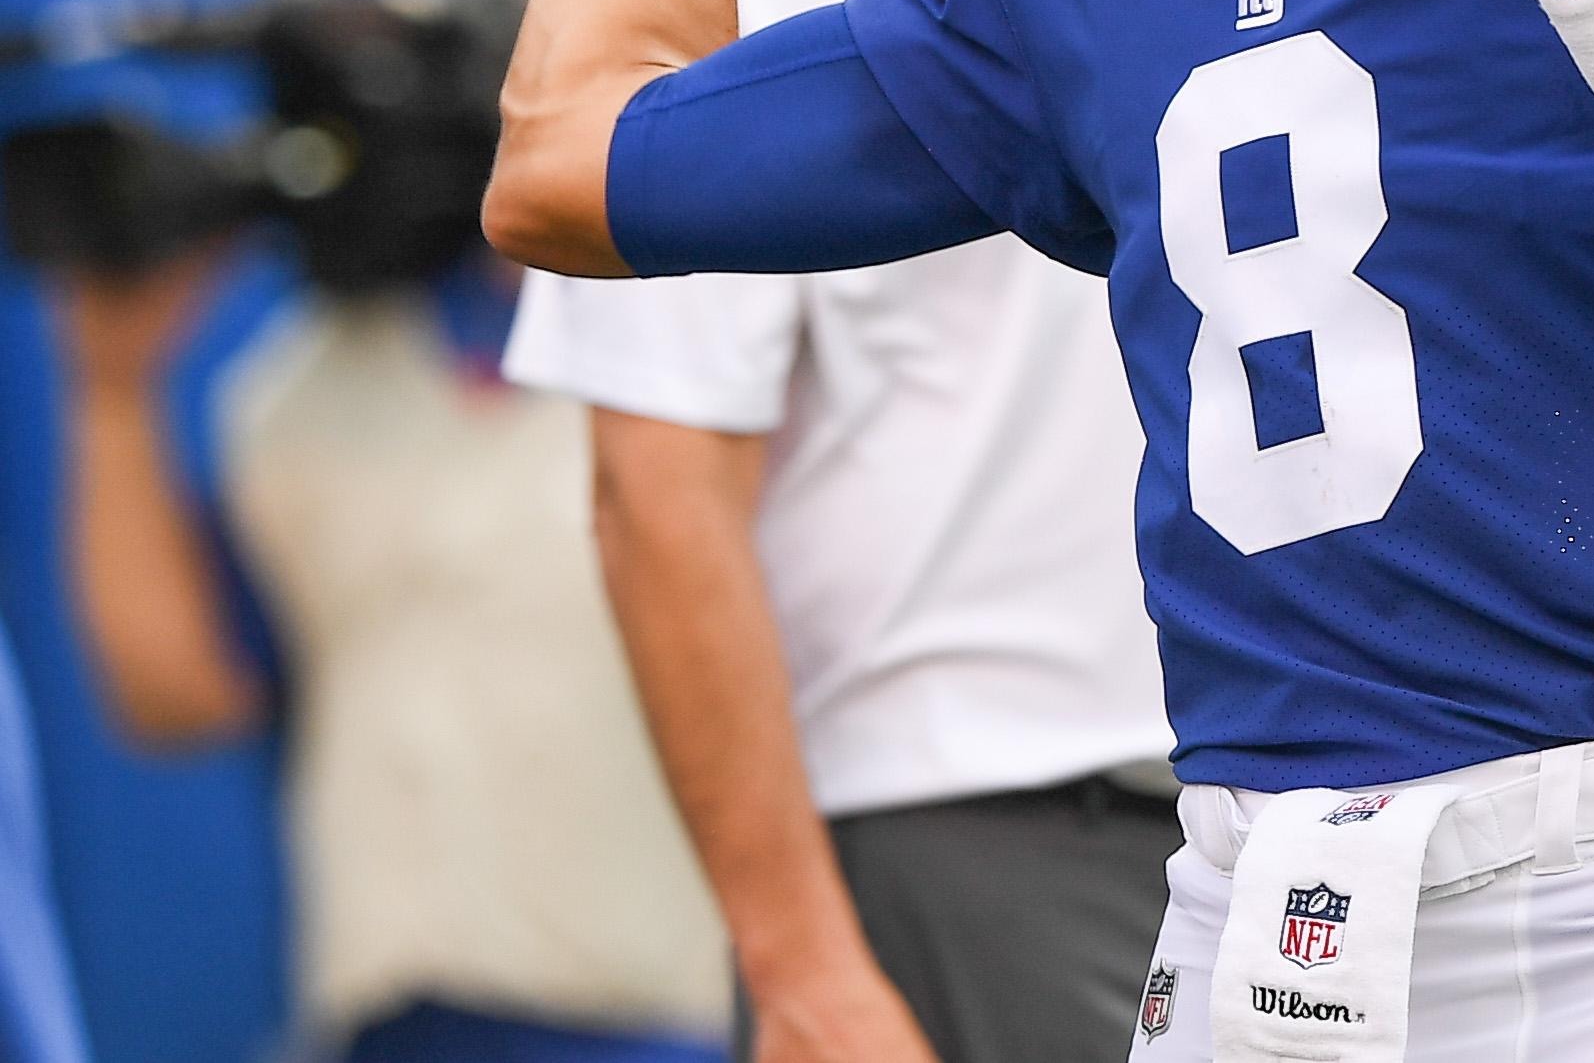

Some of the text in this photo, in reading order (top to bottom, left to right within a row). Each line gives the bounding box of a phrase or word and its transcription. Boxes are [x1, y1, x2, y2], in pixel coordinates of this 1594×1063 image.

[1154, 28, 1425, 558] 8
[1282, 918, 1338, 962] NFL
[1250, 984, 1353, 1024] Wilson
